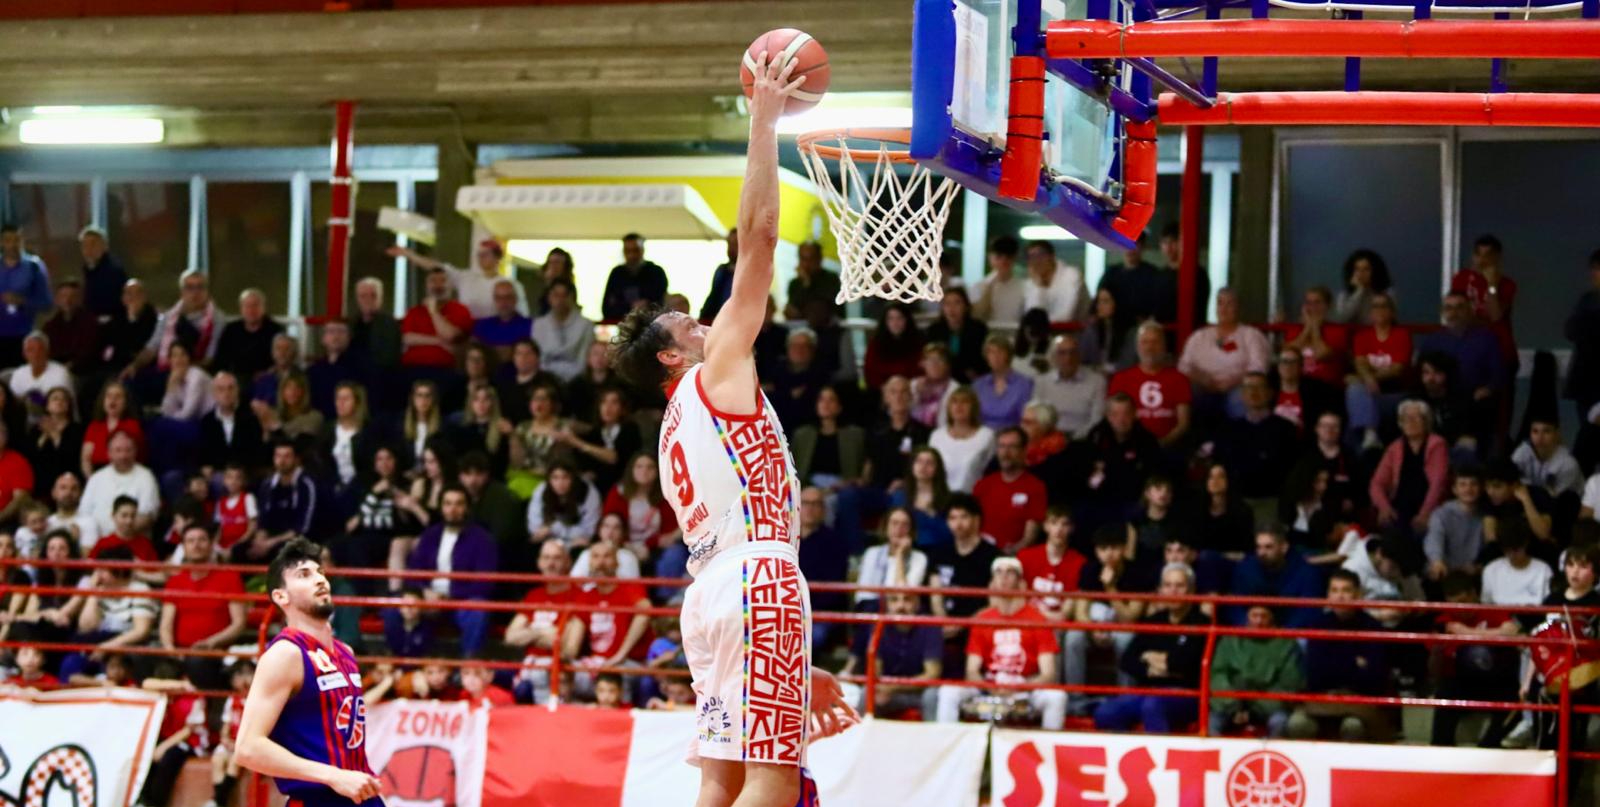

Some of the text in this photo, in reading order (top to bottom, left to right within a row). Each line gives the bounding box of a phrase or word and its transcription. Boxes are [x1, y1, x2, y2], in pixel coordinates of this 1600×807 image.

[1139, 381, 1163, 409] 6
[670, 440, 695, 507] 9
[396, 709, 463, 738] ZONA
